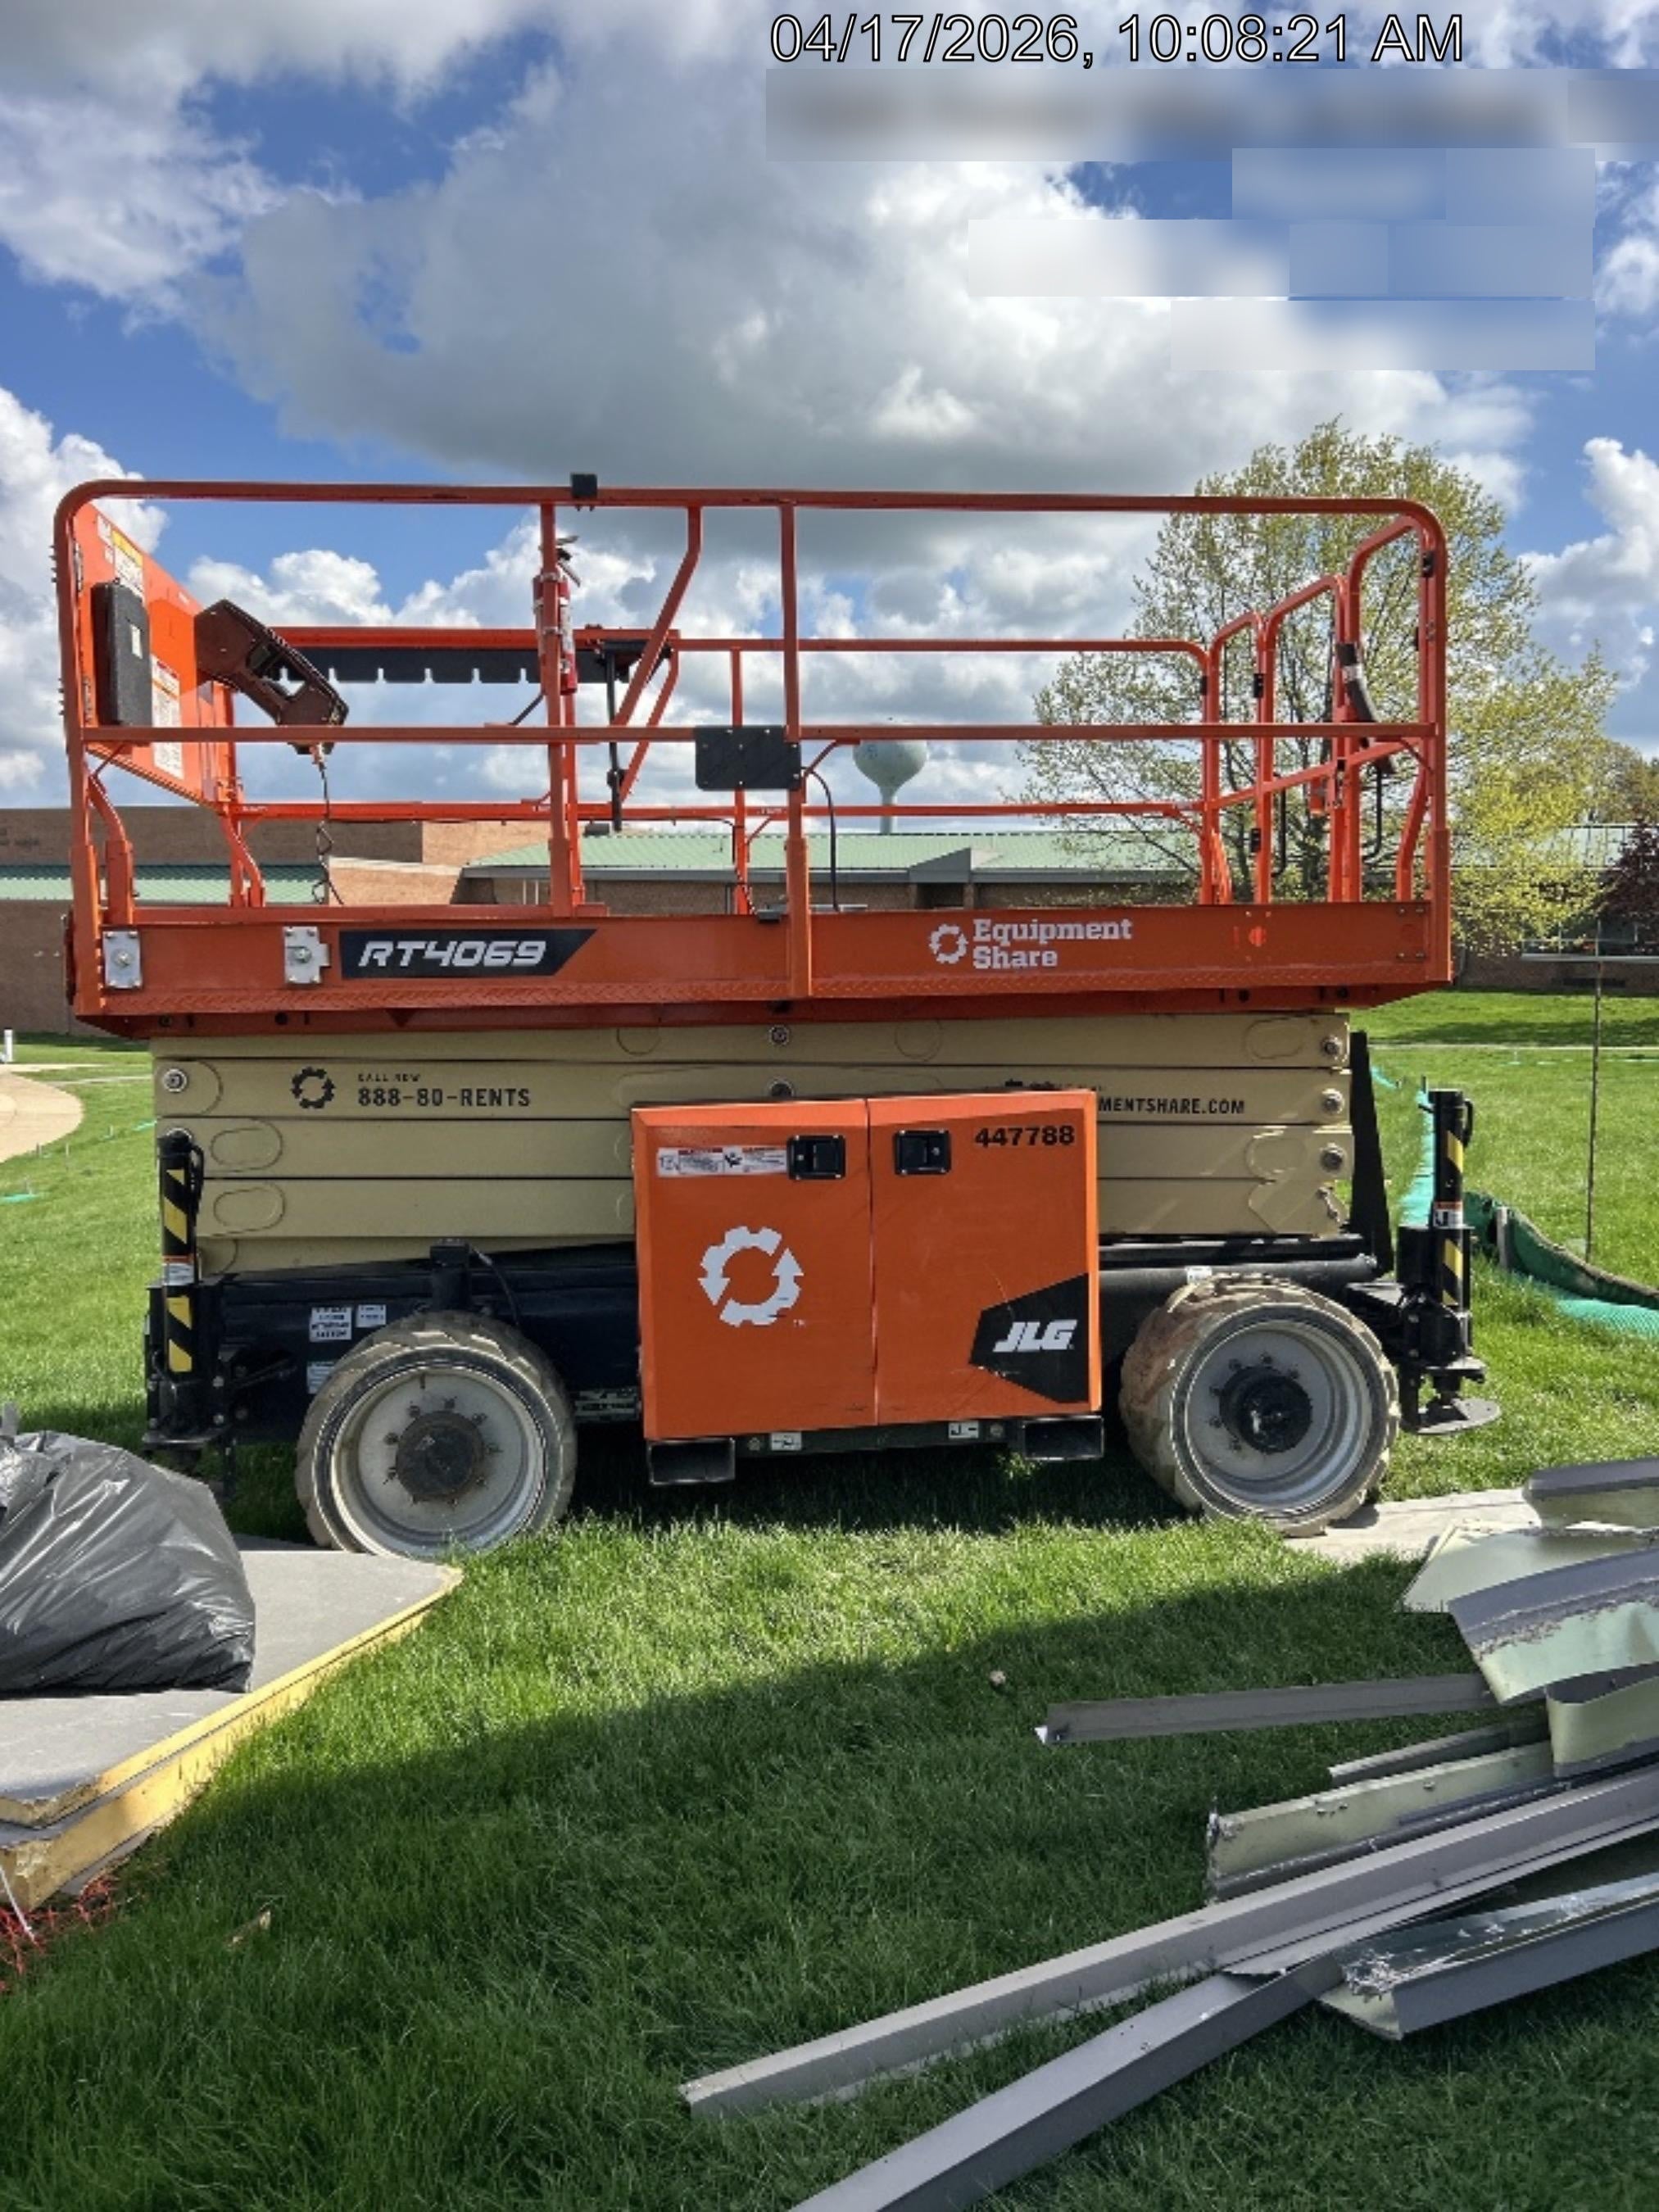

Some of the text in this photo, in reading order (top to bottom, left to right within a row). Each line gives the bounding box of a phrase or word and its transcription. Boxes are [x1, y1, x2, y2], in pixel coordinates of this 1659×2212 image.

[973, 918, 1133, 946] Equipment
[358, 941, 546, 967] RT4069
[972, 945, 1058, 970] Share
[358, 1073, 421, 1082] CALL NOW
[358, 1087, 530, 1107] 888-80-RENTS
[974, 1126, 1076, 1148] 447788
[992, 1319, 1078, 1353] JLG
